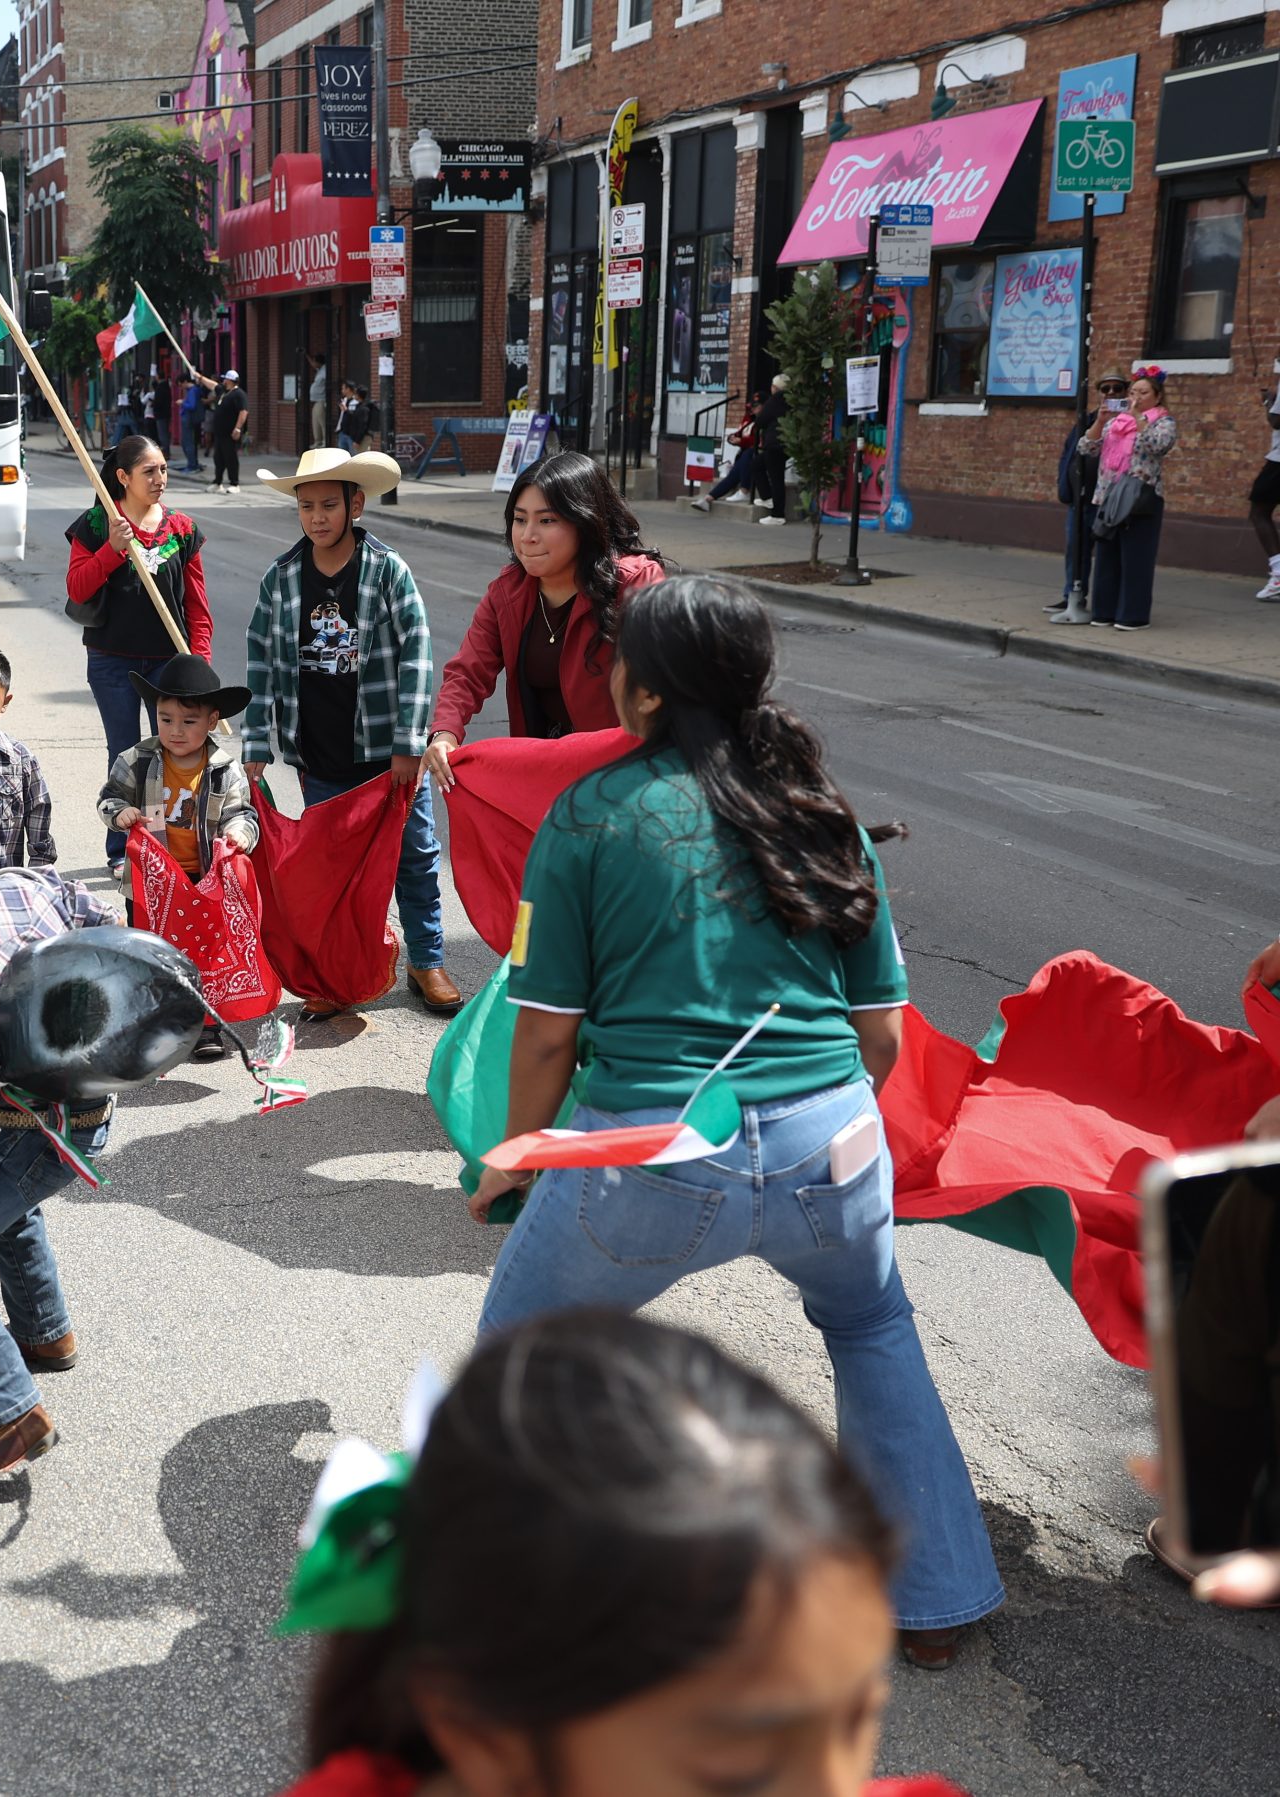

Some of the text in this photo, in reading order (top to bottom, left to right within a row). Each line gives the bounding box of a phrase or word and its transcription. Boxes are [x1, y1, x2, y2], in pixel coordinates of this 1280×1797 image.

[320, 64, 367, 87] JOY
[342, 91, 350, 101] in
[351, 93, 367, 101] our
[321, 103, 368, 113] classrooms
[1061, 89, 1128, 119] Tonantzin
[323, 121, 369, 138] PEREZ
[458, 144, 504, 153] CHICAGO
[441, 154, 524, 162] ELLPHONE REPAIR
[1057, 175, 1131, 186] East to Lakefront
[806, 152, 990, 232] Tonantzin
[913, 206, 929, 215] bus
[913, 215, 931, 224] stop
[624, 228, 637, 237] BUS
[624, 235, 639, 245] STOP
[281, 230, 340, 281] LIQUORS
[1004, 260, 1078, 306] Gallery
[1042, 284, 1075, 309] Shop
[396, 444, 419, 453] EXIT
